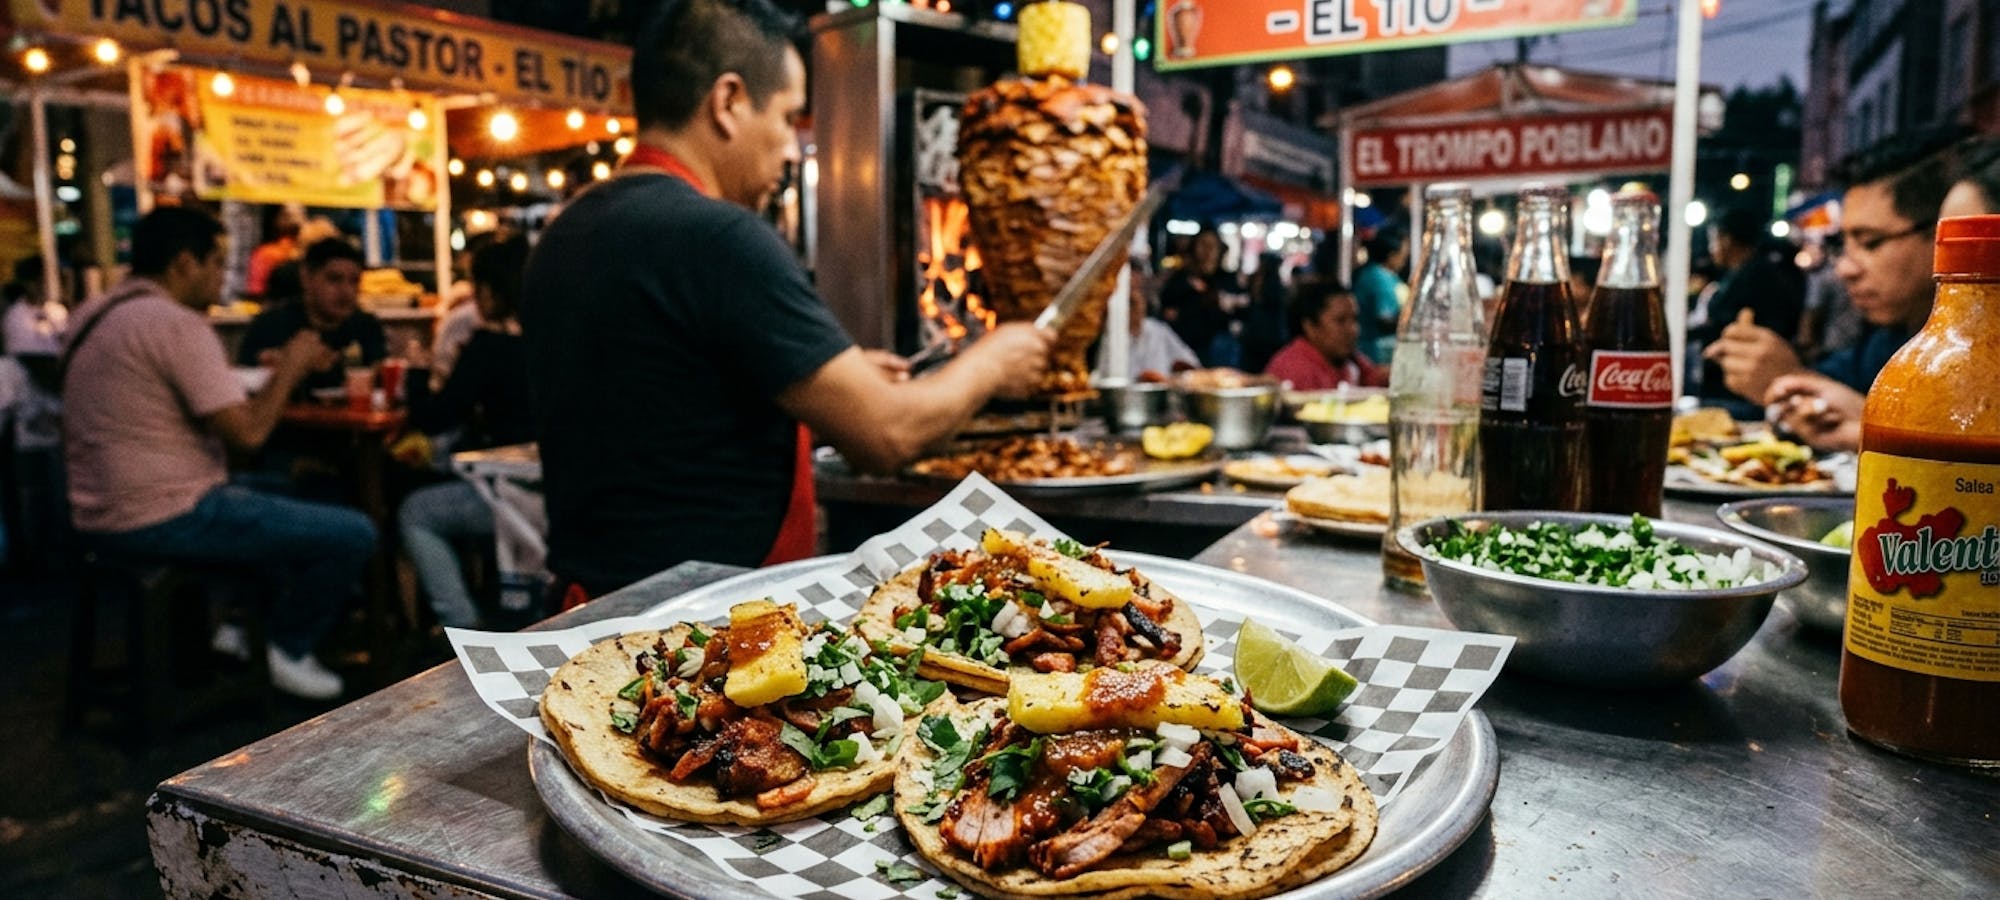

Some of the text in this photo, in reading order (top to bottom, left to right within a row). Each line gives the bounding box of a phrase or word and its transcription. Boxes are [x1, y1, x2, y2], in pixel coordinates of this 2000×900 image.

[1312, 0, 1359, 35] EL
[269, 3, 324, 54] AL
[337, 16, 485, 79] PASTOR
[515, 48, 551, 91] EL
[1357, 136, 1390, 175] EL
[1394, 126, 1515, 173] TROMPO
[1520, 116, 1666, 165] POBLANO
[1878, 525, 2000, 576] Valent
